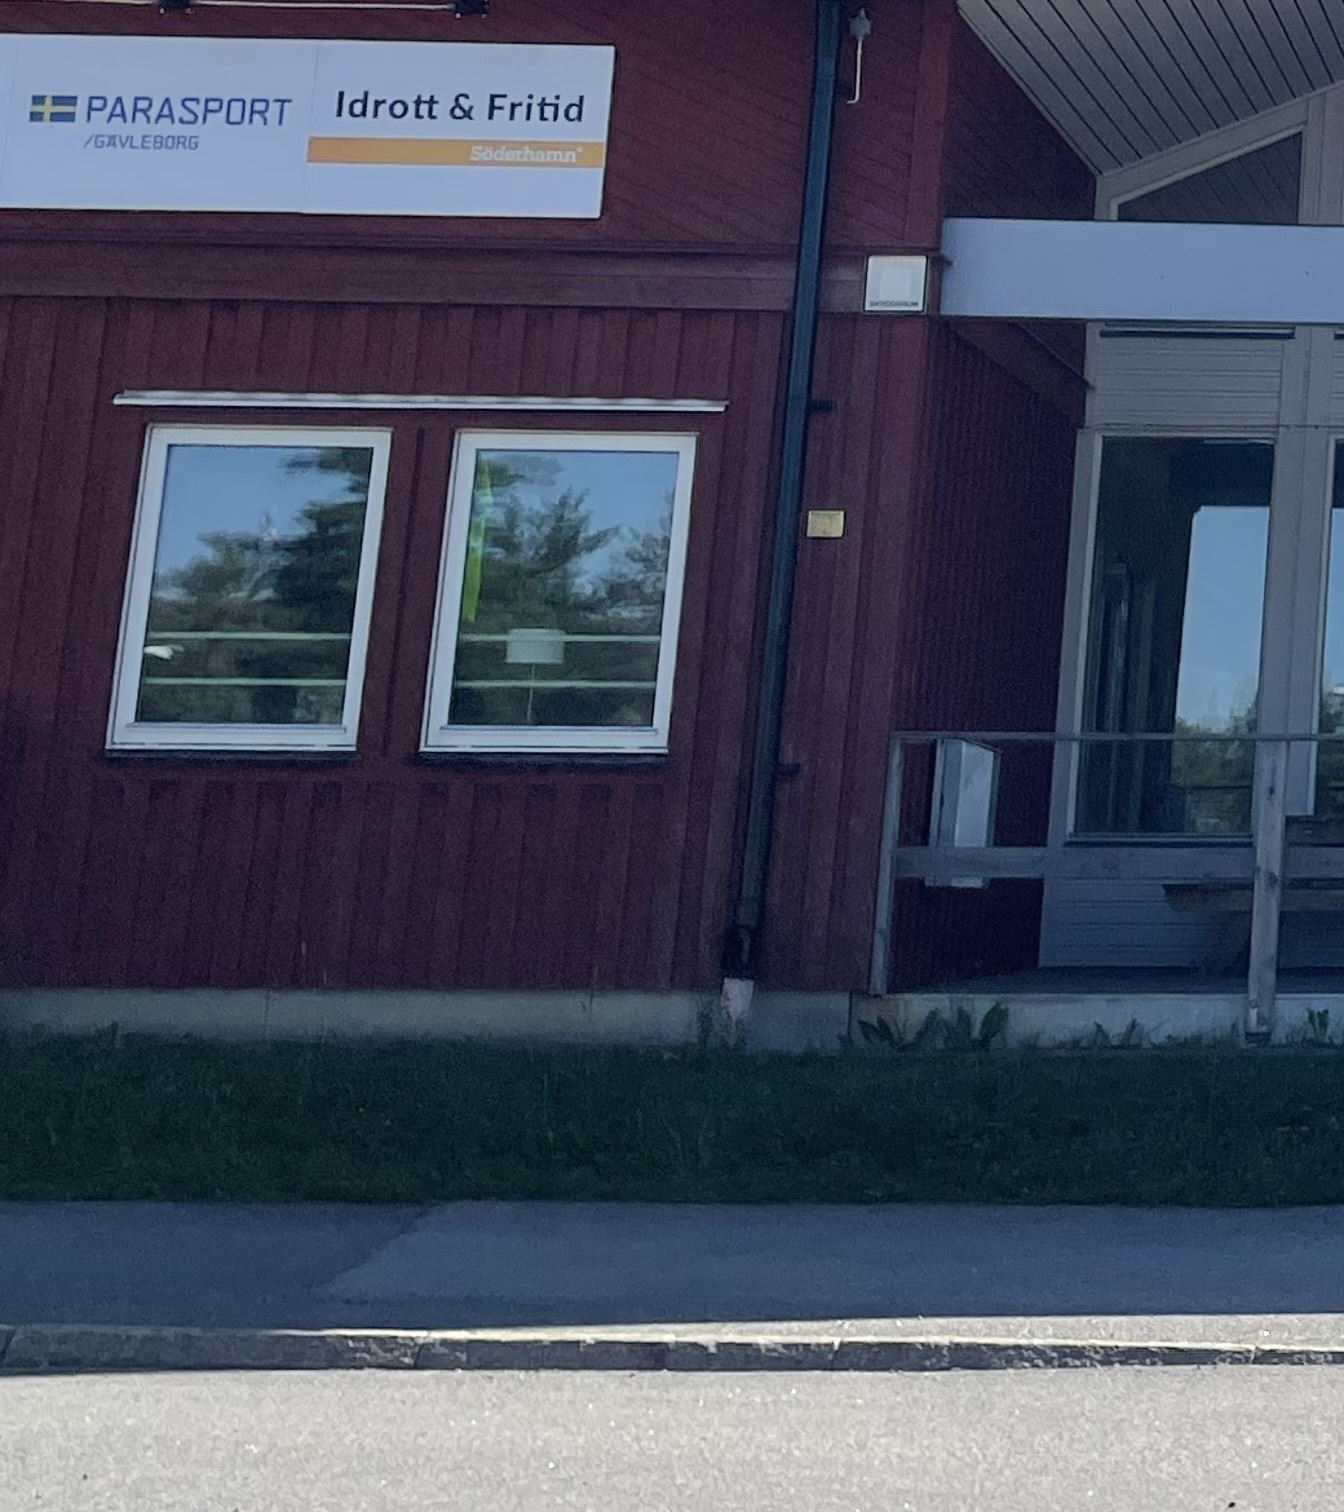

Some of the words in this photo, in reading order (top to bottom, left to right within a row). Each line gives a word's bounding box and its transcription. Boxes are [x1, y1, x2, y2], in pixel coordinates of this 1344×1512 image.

[86, 95, 292, 126] PARASPORT
[335, 90, 438, 120] Idrott
[449, 92, 475, 121] &
[487, 94, 586, 122] Fritid
